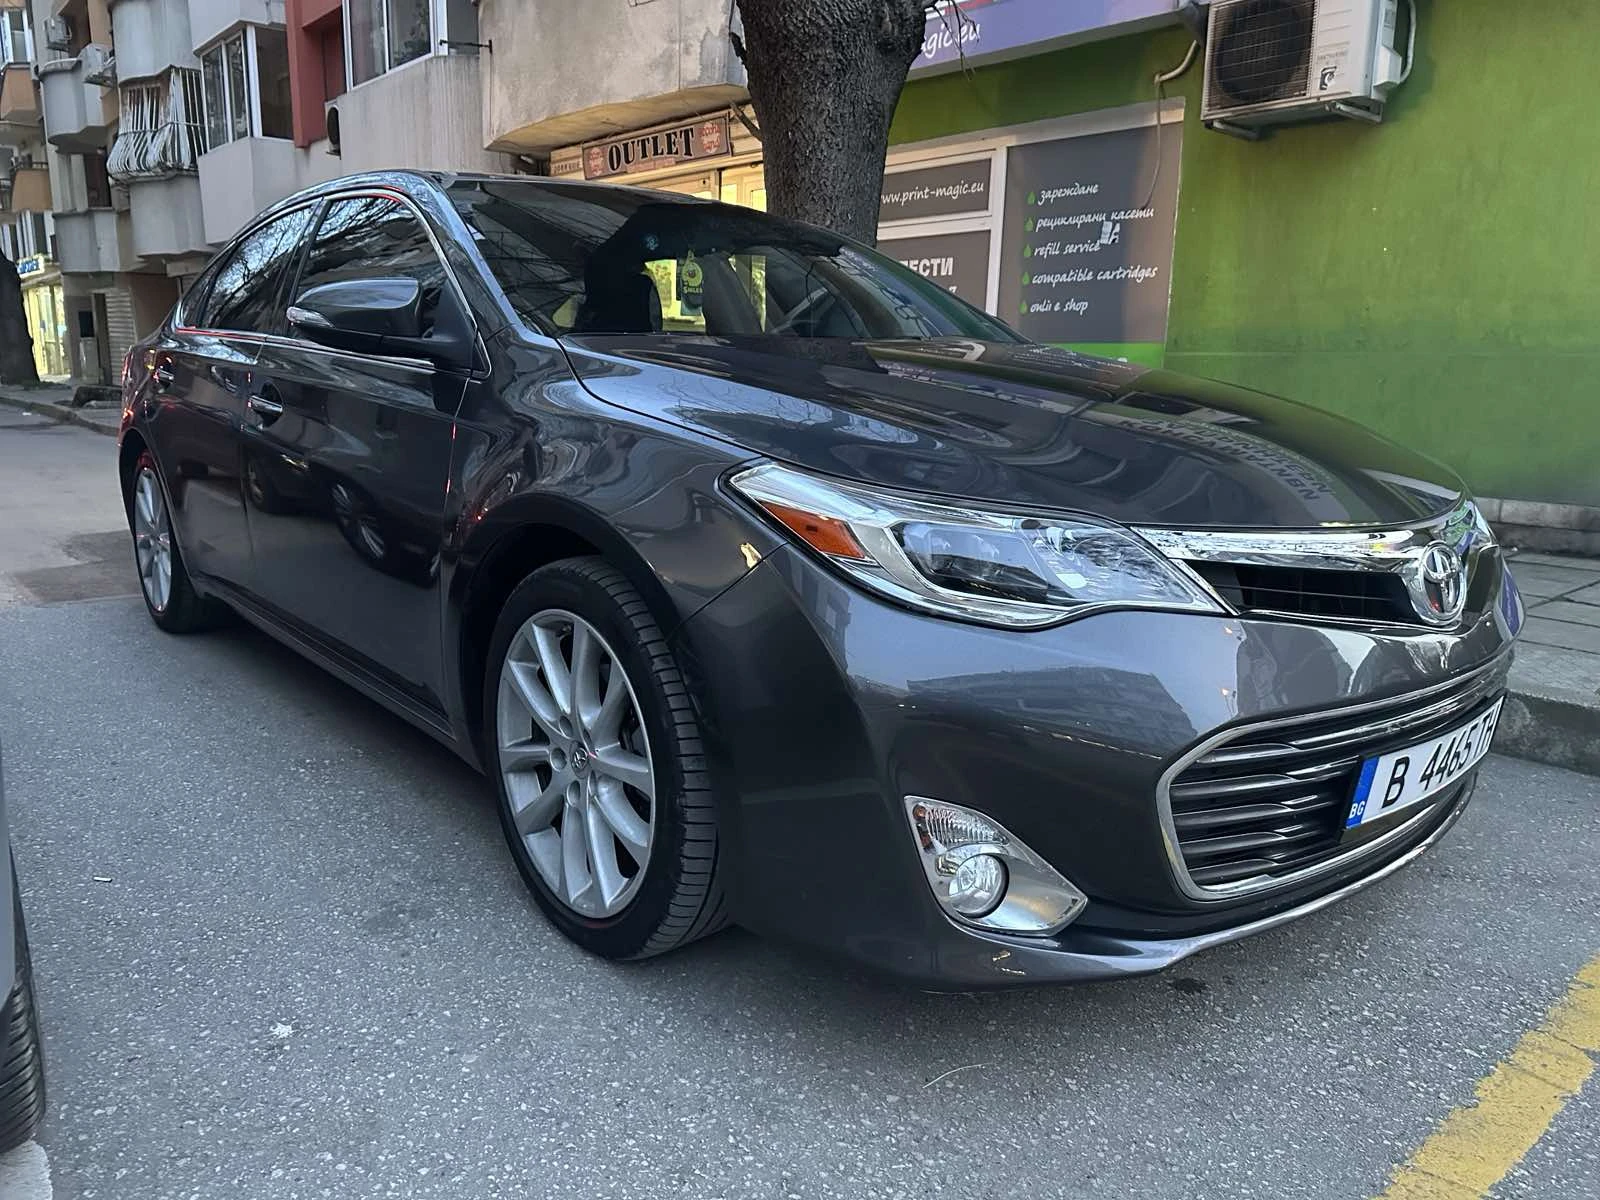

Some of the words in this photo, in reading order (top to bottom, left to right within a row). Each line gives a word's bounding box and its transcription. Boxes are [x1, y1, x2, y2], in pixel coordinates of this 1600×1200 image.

[608, 128, 695, 171] OUTLET
[880, 179, 984, 206] ww.print-magic.eu
[1037, 182, 1099, 206] зареждане
[1035, 211, 1106, 232] рециклирани
[1110, 207, 1154, 221] касети
[1034, 242, 1060, 259] refill
[1063, 239, 1101, 254] service
[1032, 267, 1093, 288] compatible
[1097, 264, 1158, 283] cartridges
[1063, 298, 1089, 316] shop
[1381, 755, 1410, 809] B
[1419, 722, 1479, 791] 4465
[1348, 800, 1366, 819] BG
